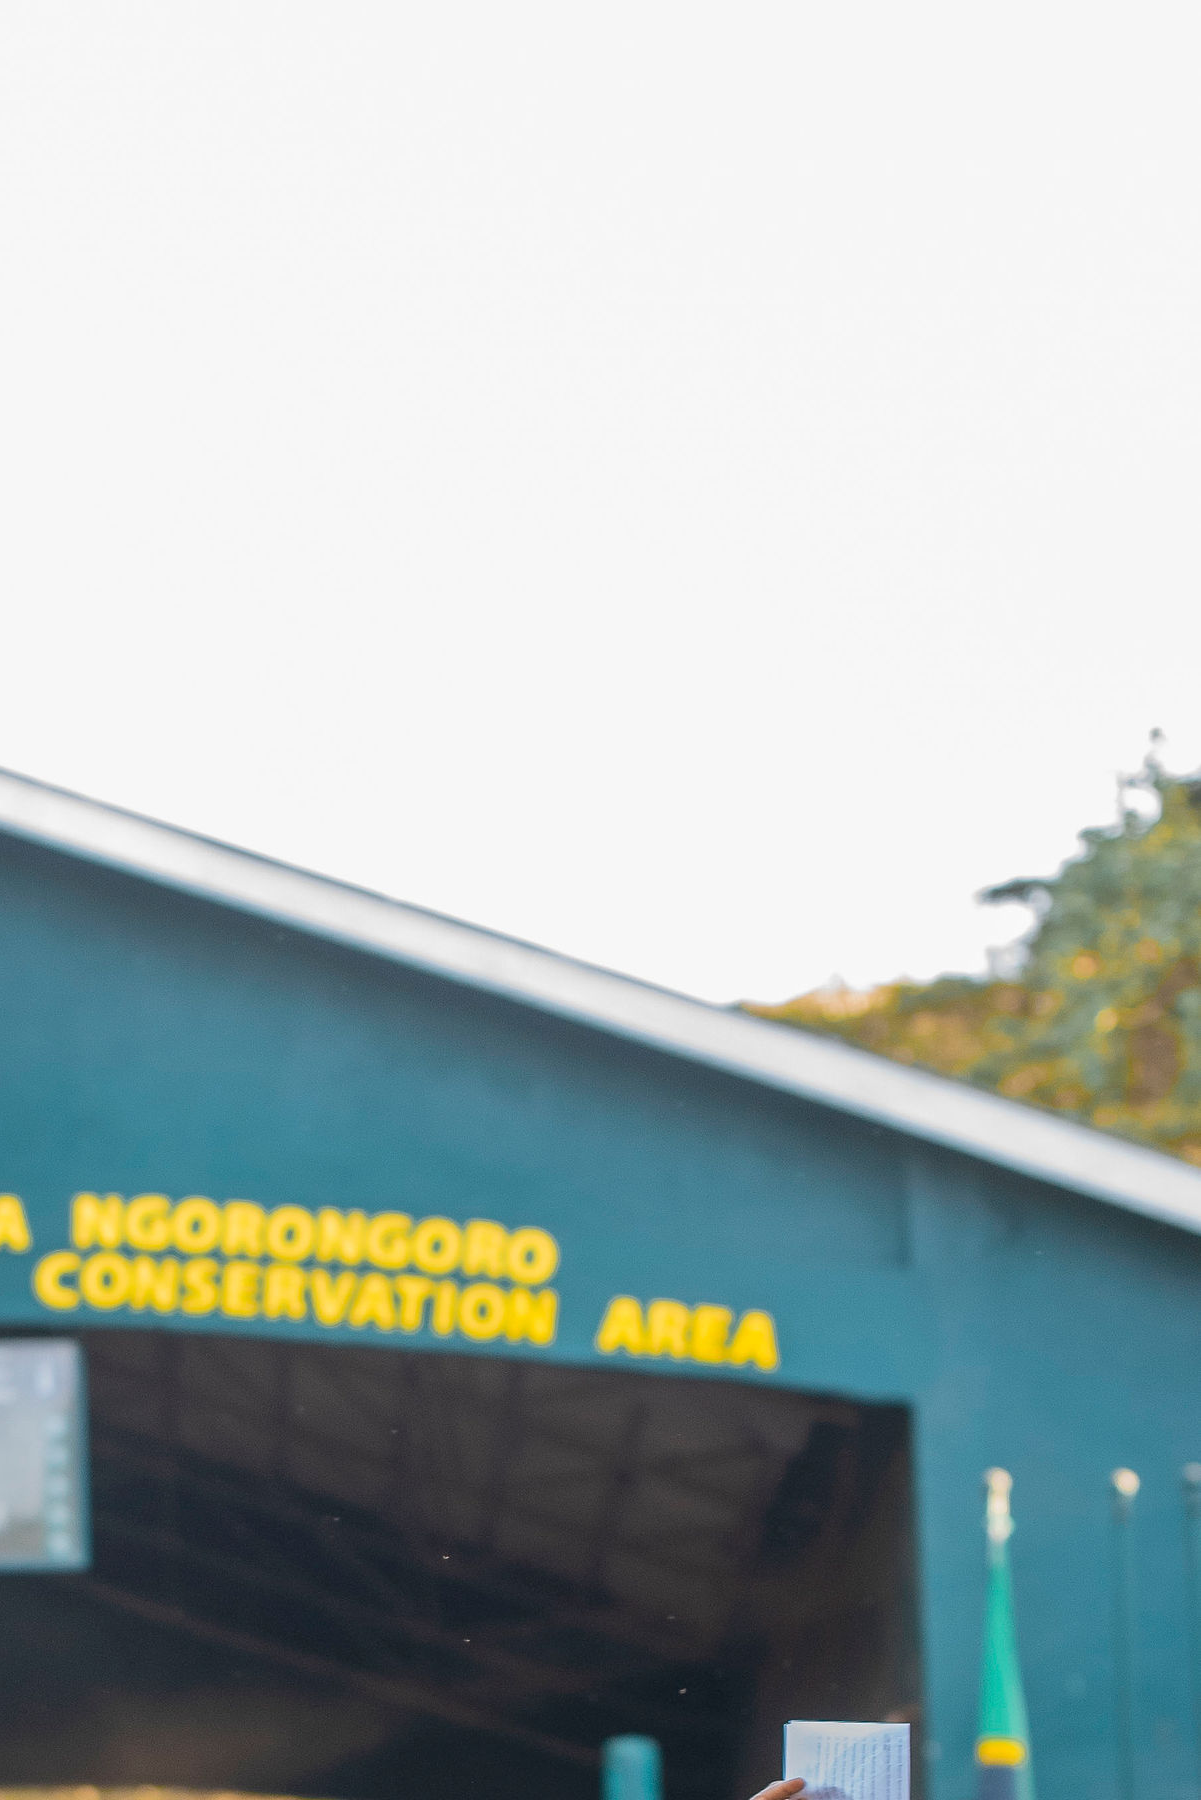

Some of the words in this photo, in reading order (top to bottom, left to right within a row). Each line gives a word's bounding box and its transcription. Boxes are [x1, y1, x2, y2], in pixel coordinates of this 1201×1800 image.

[73, 1195, 556, 1287] NGORONGORO
[35, 1252, 556, 1344] CONSERVATION
[598, 1298, 777, 1369] AREA
